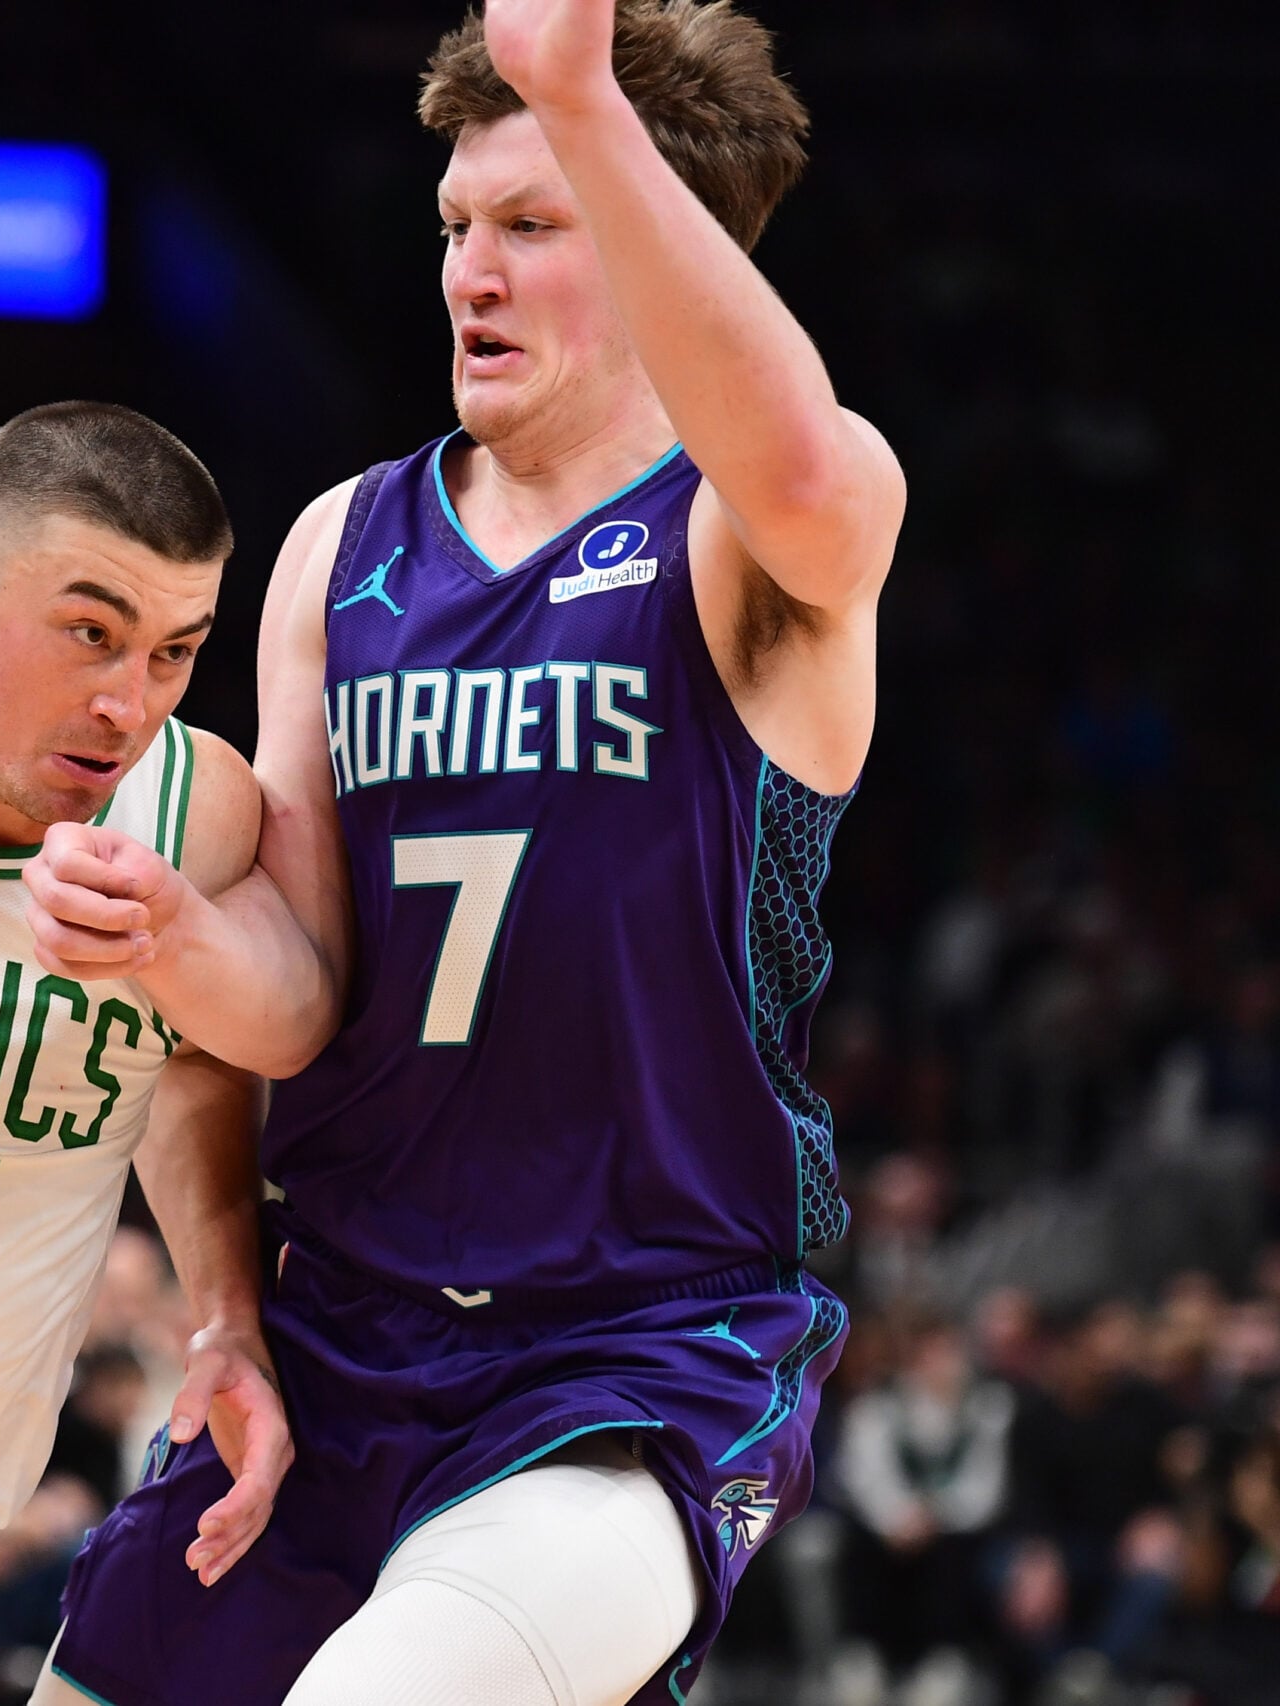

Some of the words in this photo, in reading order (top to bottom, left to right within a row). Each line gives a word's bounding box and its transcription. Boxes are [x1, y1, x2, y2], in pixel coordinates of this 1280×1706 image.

[553, 575, 595, 598] Judi
[598, 562, 654, 588] Health
[324, 660, 664, 798] HORNETS
[390, 828, 533, 1046] 7
